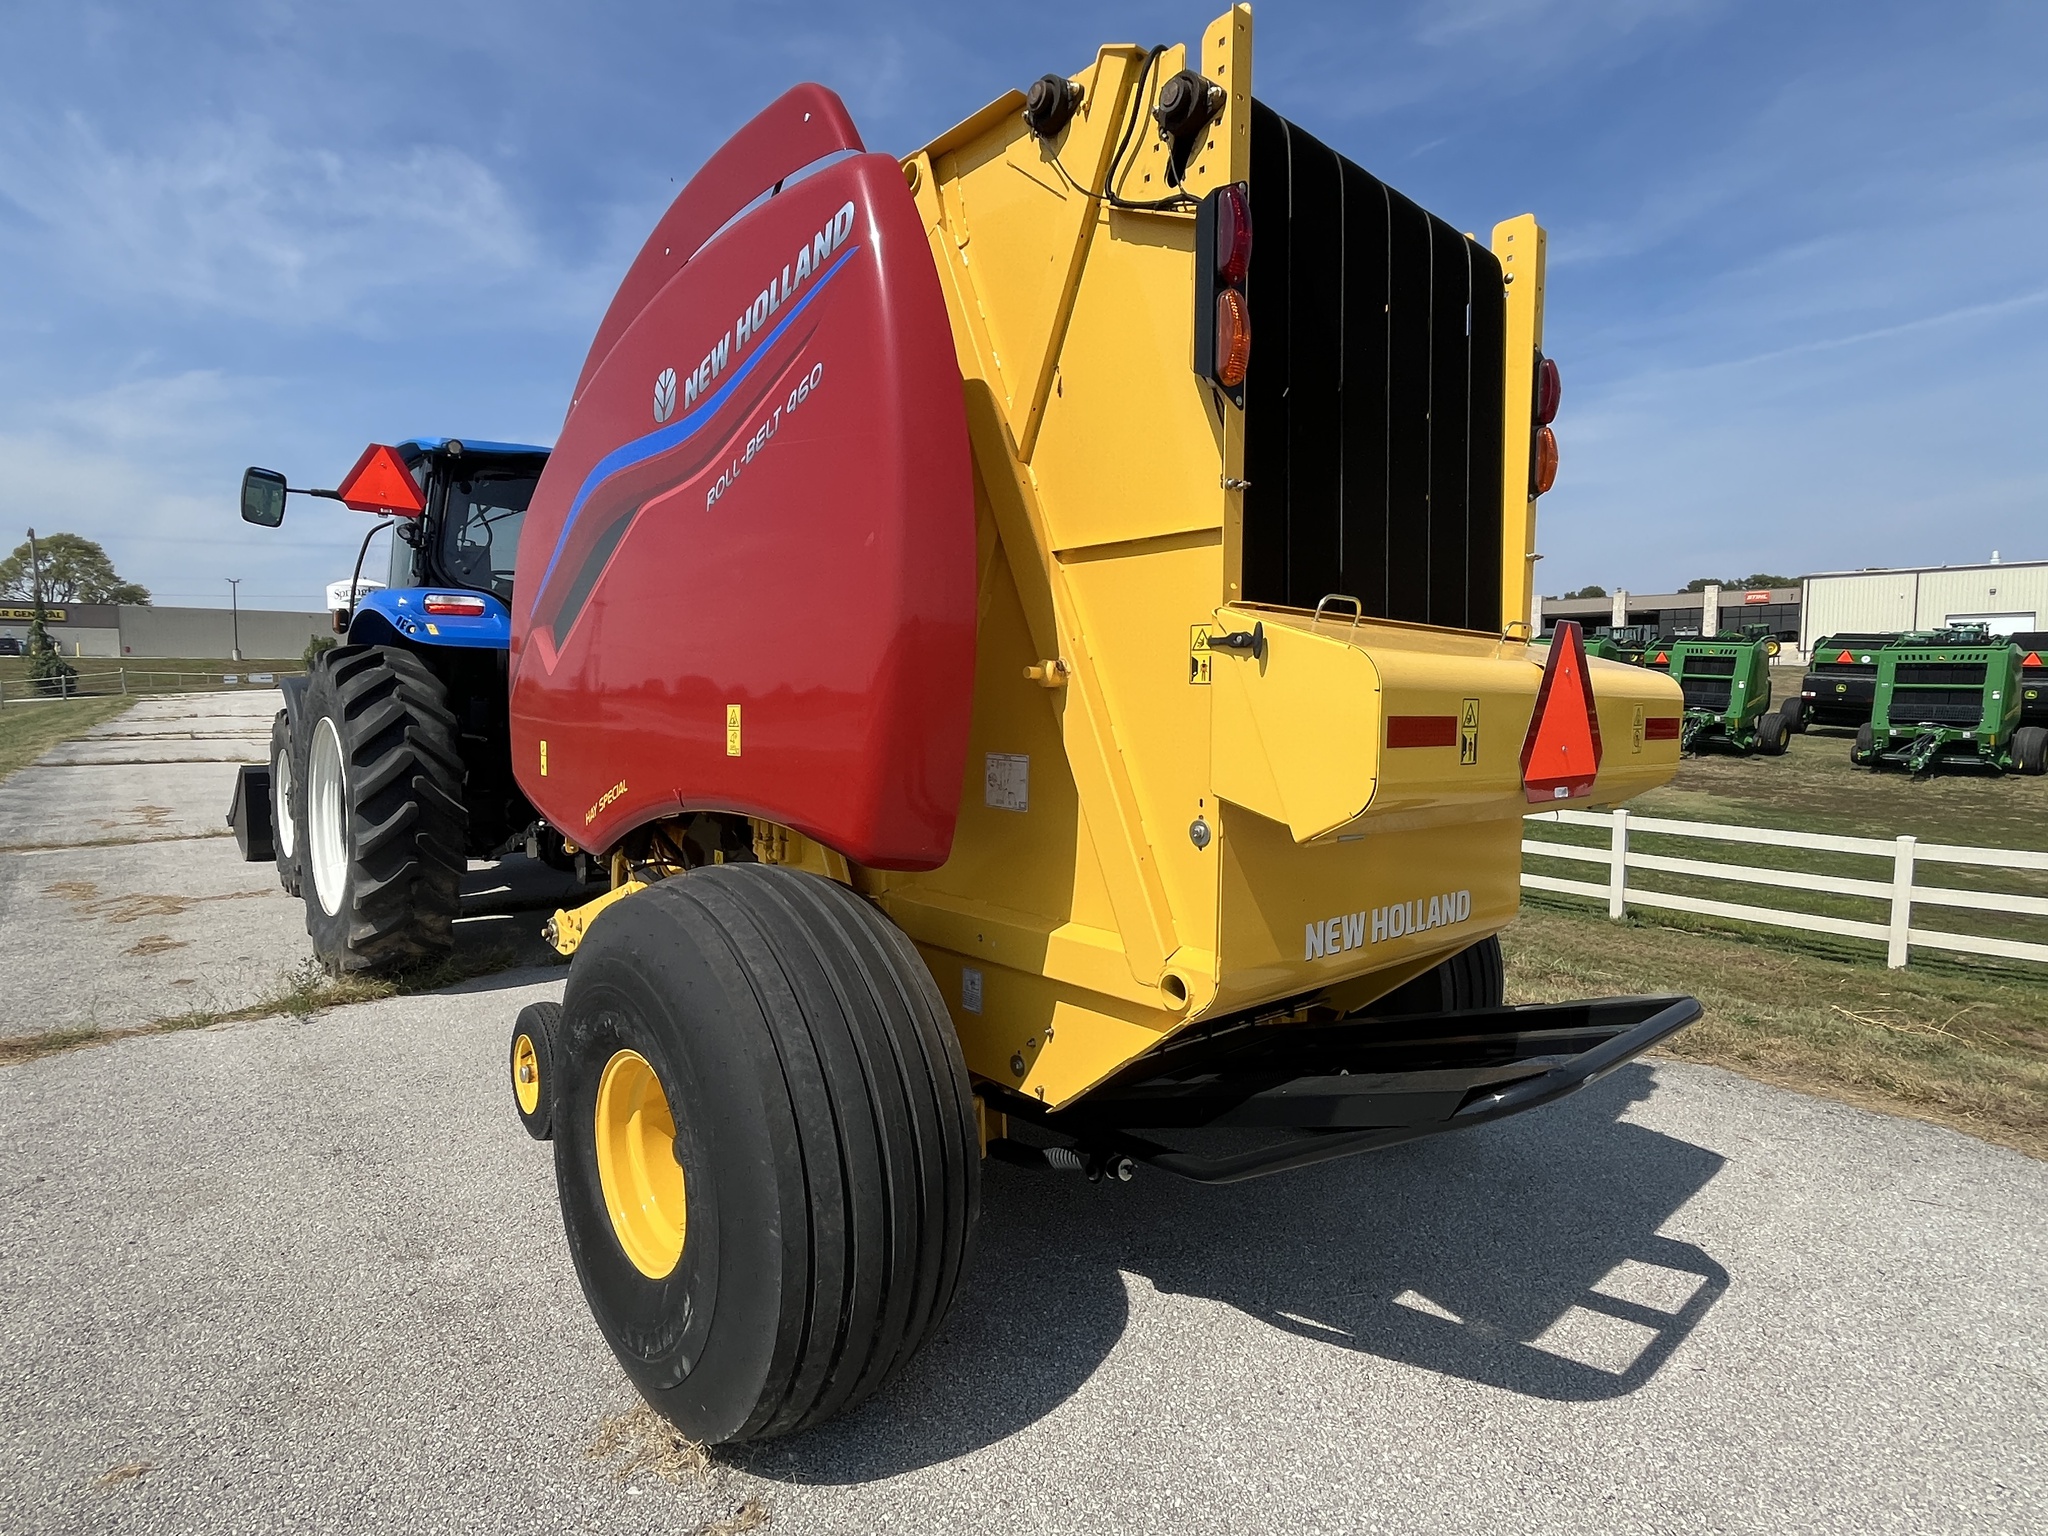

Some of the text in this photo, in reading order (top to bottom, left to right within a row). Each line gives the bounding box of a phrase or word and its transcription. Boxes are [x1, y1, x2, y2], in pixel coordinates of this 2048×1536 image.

[684, 201, 855, 410] NEW HOLLAND
[706, 362, 823, 512] ROLL-BELT 460
[585, 779, 629, 826] HAY SPECIAL
[1304, 889, 1472, 961] NEW HOLLAND
